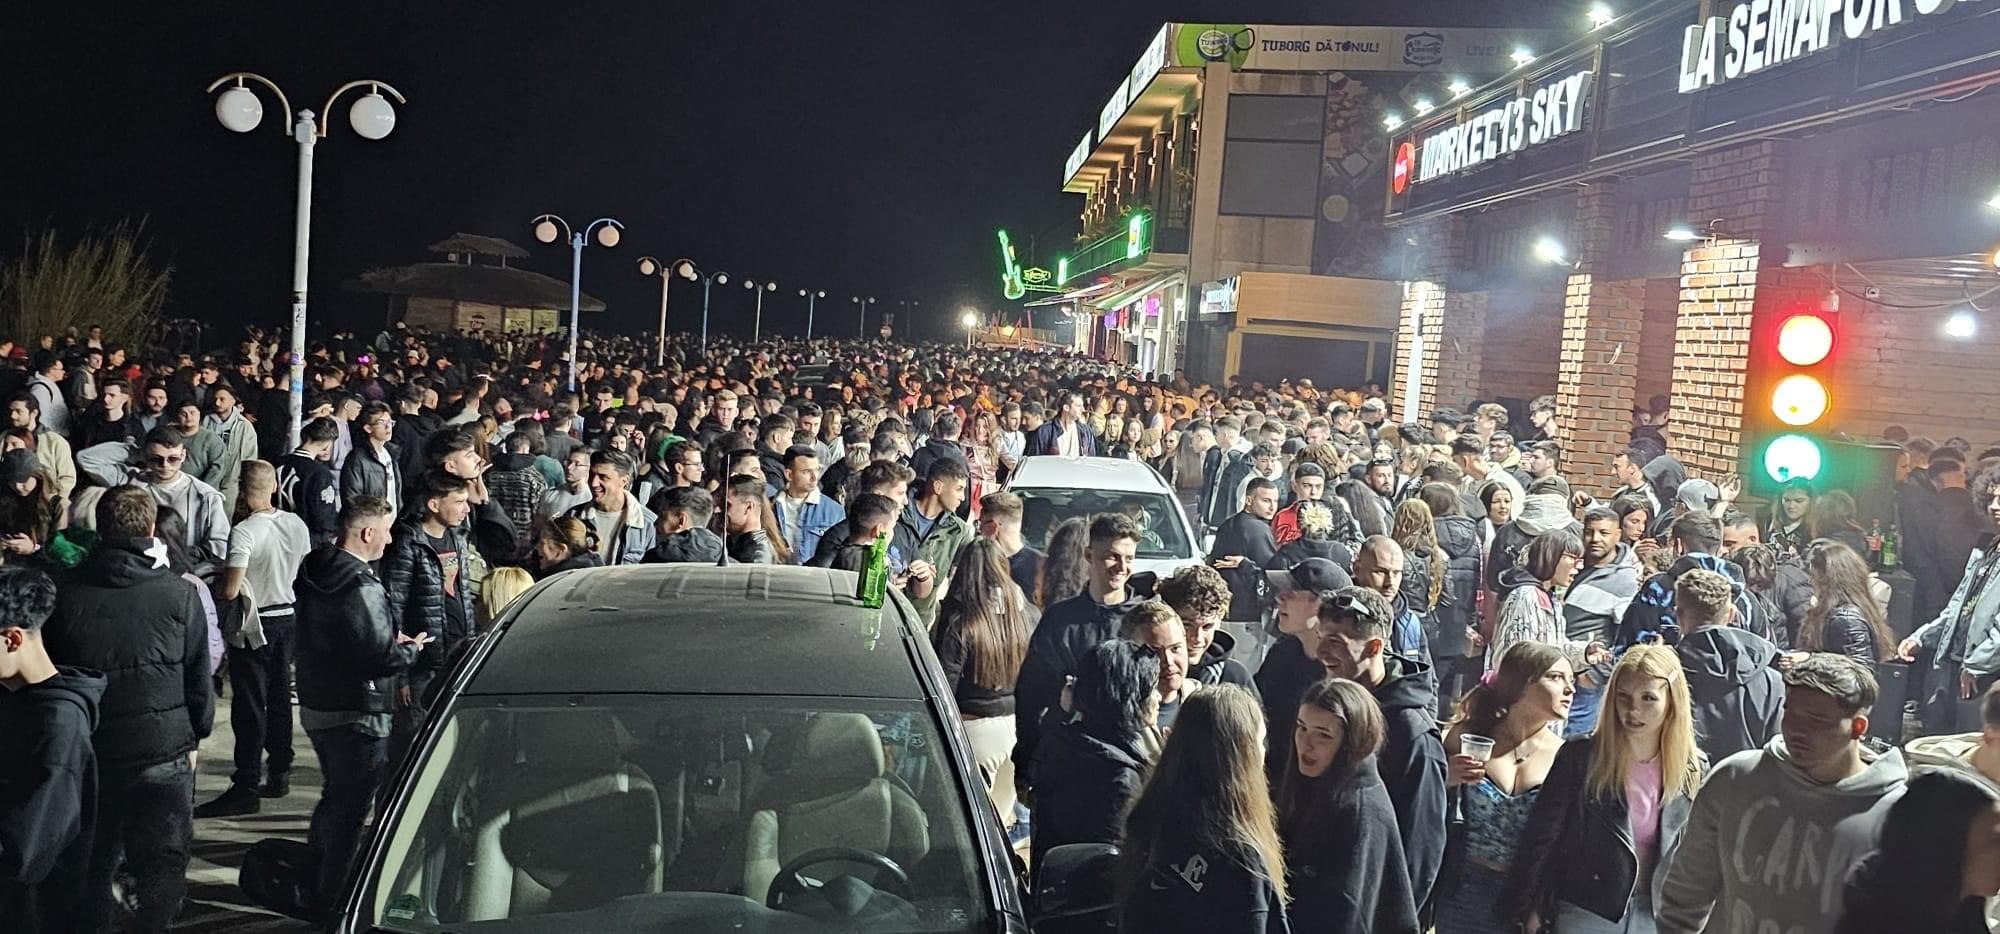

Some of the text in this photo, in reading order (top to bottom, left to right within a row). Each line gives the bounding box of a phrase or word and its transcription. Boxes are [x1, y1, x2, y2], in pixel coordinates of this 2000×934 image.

[1262, 40, 1310, 53] TUBORG
[1316, 39, 1332, 52] DĂ
[1678, 16, 1724, 94] LA
[1420, 109, 1504, 182] MARKET
[1529, 71, 1592, 145] SKY
